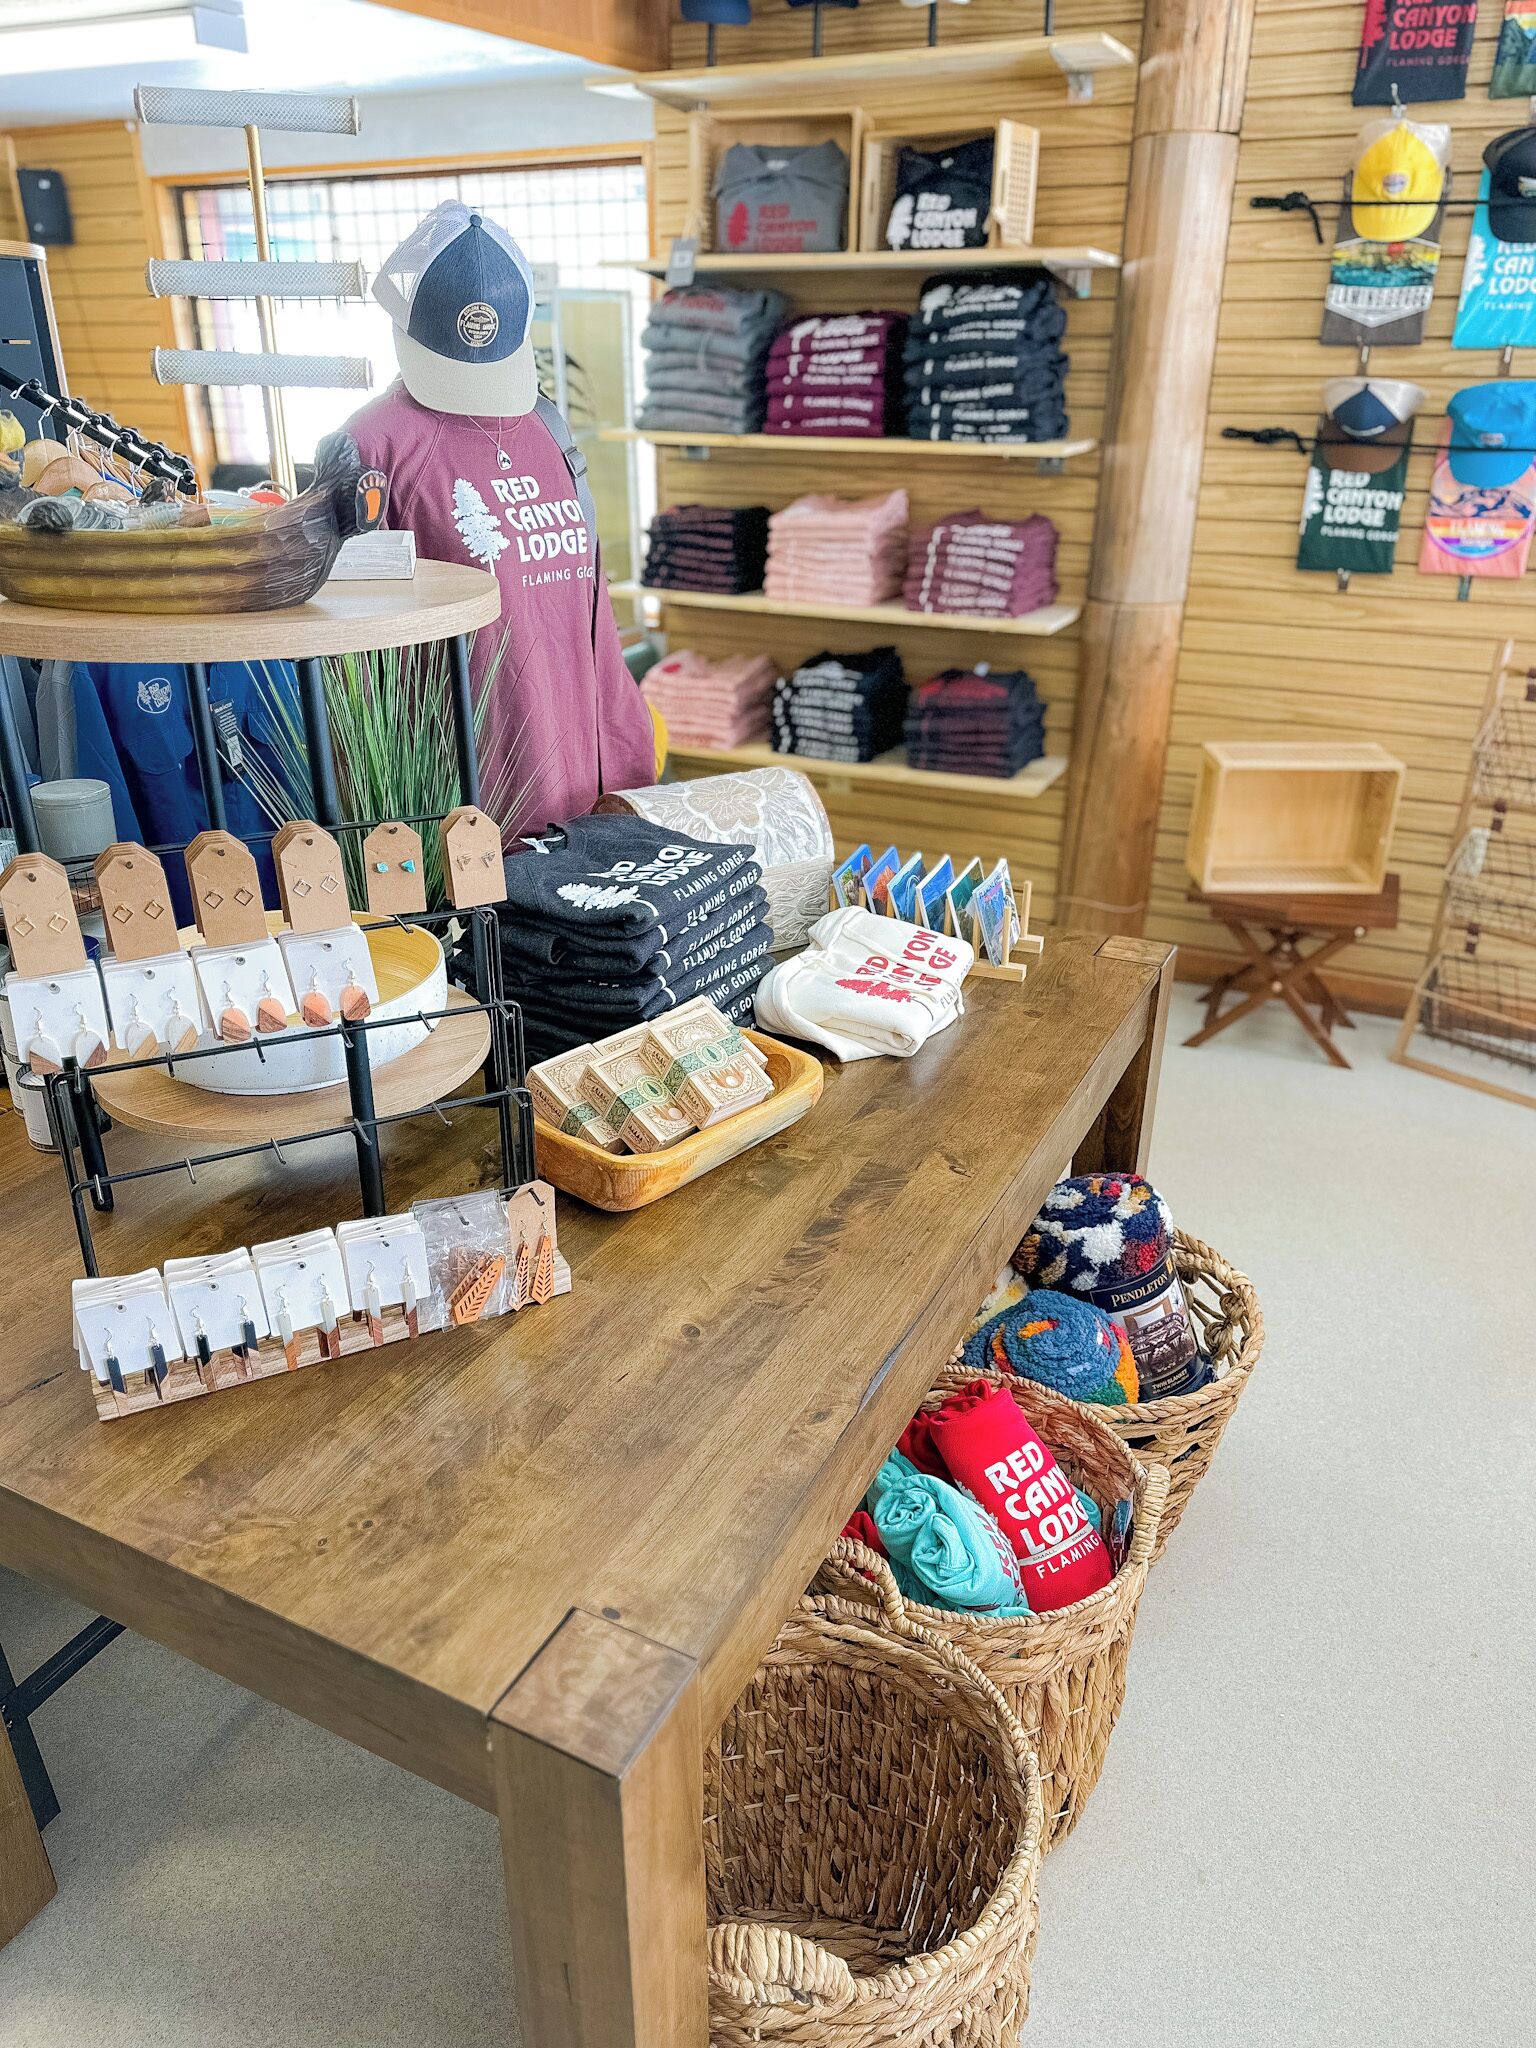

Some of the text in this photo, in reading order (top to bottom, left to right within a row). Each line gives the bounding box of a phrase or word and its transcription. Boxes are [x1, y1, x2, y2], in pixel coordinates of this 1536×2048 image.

[1393, 3, 1477, 29] CANYON
[1389, 28, 1459, 51] LODGE
[914, 208, 978, 229] CANYON
[910, 228, 965, 249] LODGE
[490, 475, 540, 505] RED
[1329, 469, 1371, 488] RED
[1326, 487, 1404, 511] CANYON
[1323, 504, 1387, 527] LODGE
[516, 527, 588, 562] LODGE
[522, 568, 571, 587] FLAMING
[673, 850, 746, 902] FLAMING GORGE
[687, 868, 759, 925] FLAMING GORGE
[727, 901, 755, 928] GORGE
[683, 915, 757, 971] FLAMING GORGE
[695, 940, 768, 991] FLAMING GORGE
[730, 964, 762, 989] GORGE
[1110, 1271, 1168, 1308] PENDLETON
[1152, 1379, 1167, 1391] TWIN
[1166, 1367, 1188, 1385] BLANKET
[984, 1440, 1044, 1495] RED
[1032, 1529, 1087, 1562] SMALL SMALL
[1035, 1534, 1100, 1579] FLAMING
